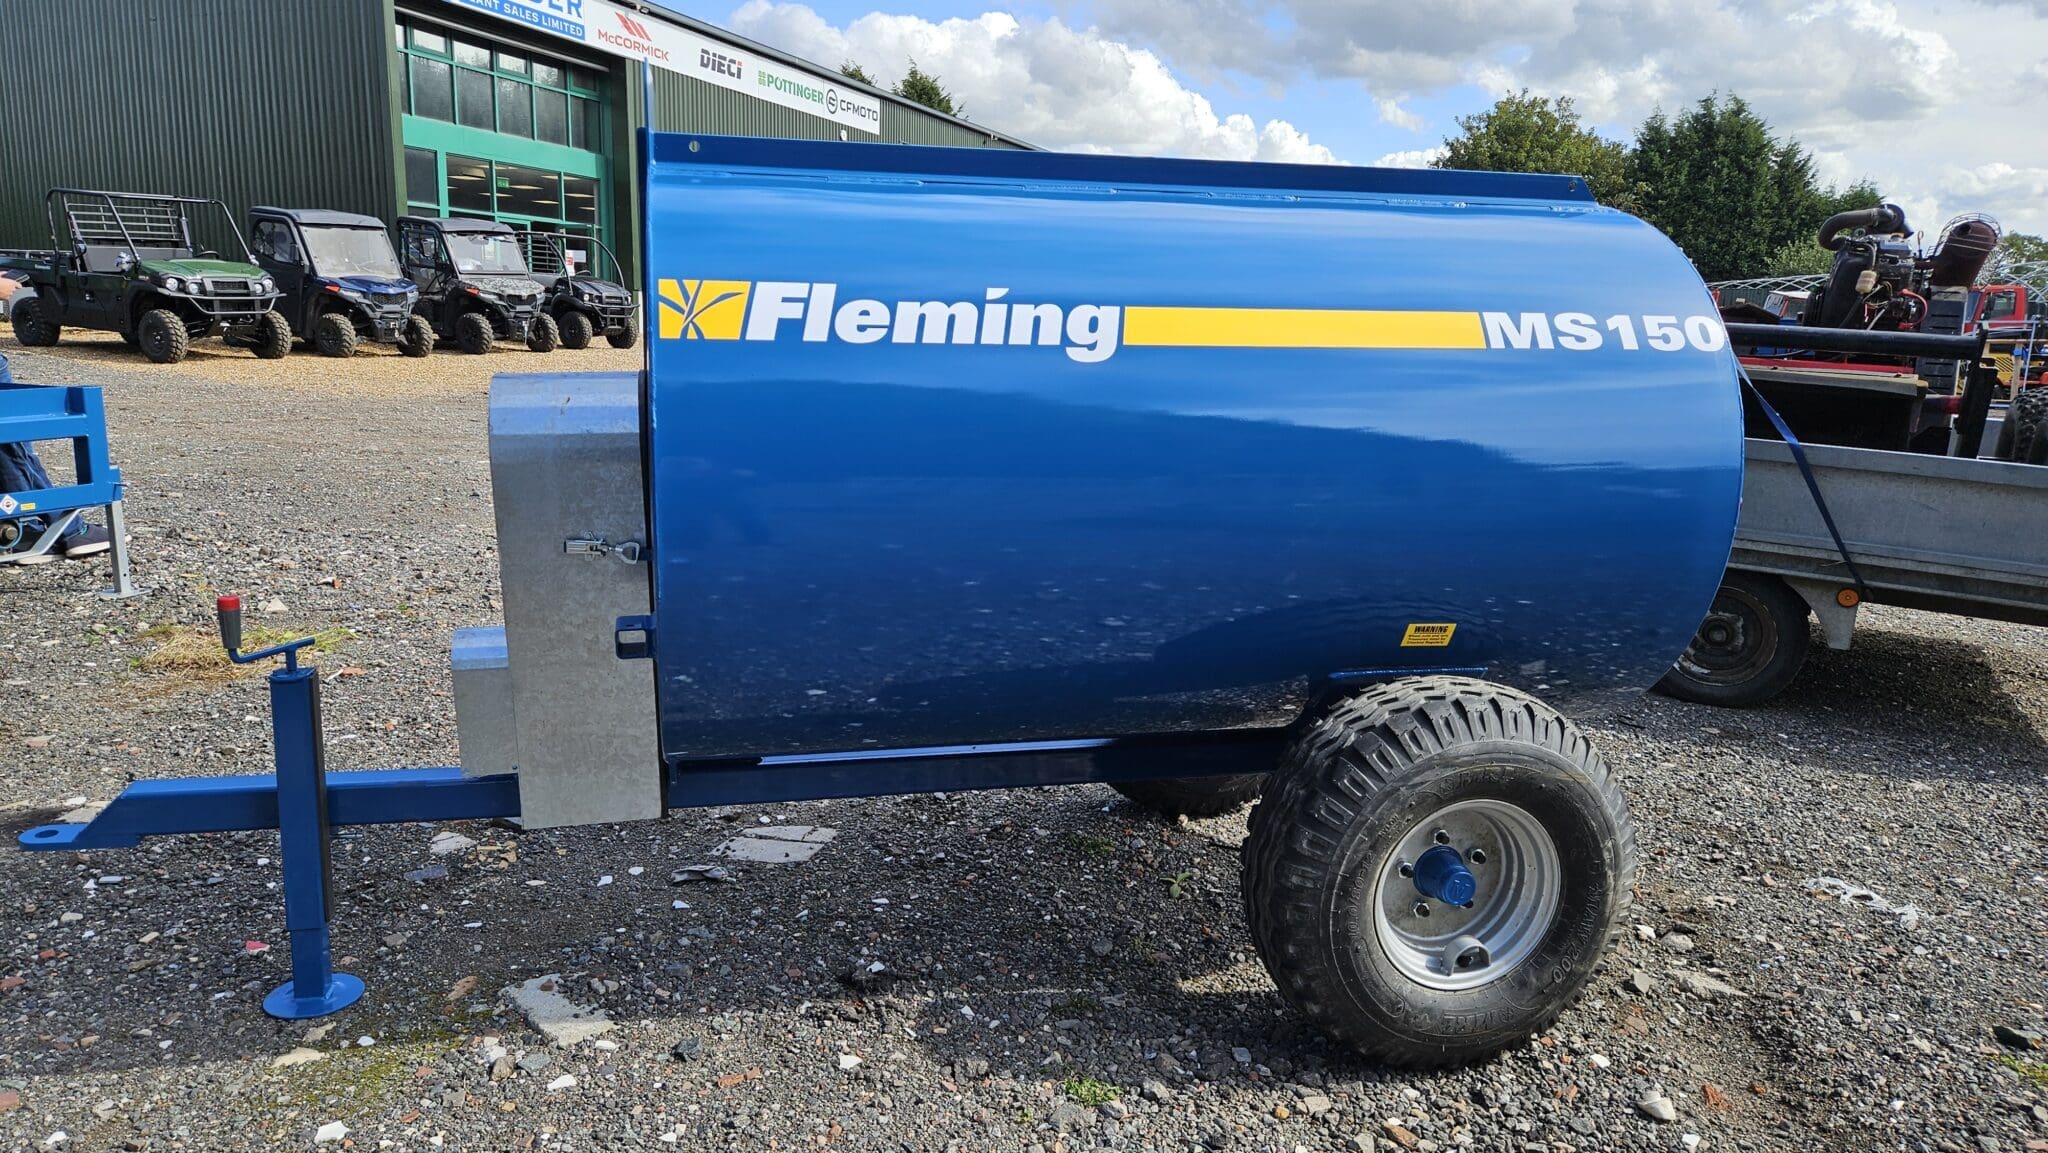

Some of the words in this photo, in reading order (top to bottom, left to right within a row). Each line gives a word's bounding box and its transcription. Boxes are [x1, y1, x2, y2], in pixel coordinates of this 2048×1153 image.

[503, 4, 539, 23] SALES
[542, 16, 583, 36] LIMITED
[598, 29, 670, 62] McCORMICK
[839, 99, 879, 122] CFMOTO
[745, 281, 1120, 363] Fleming
[1482, 312, 1726, 351] MS150
